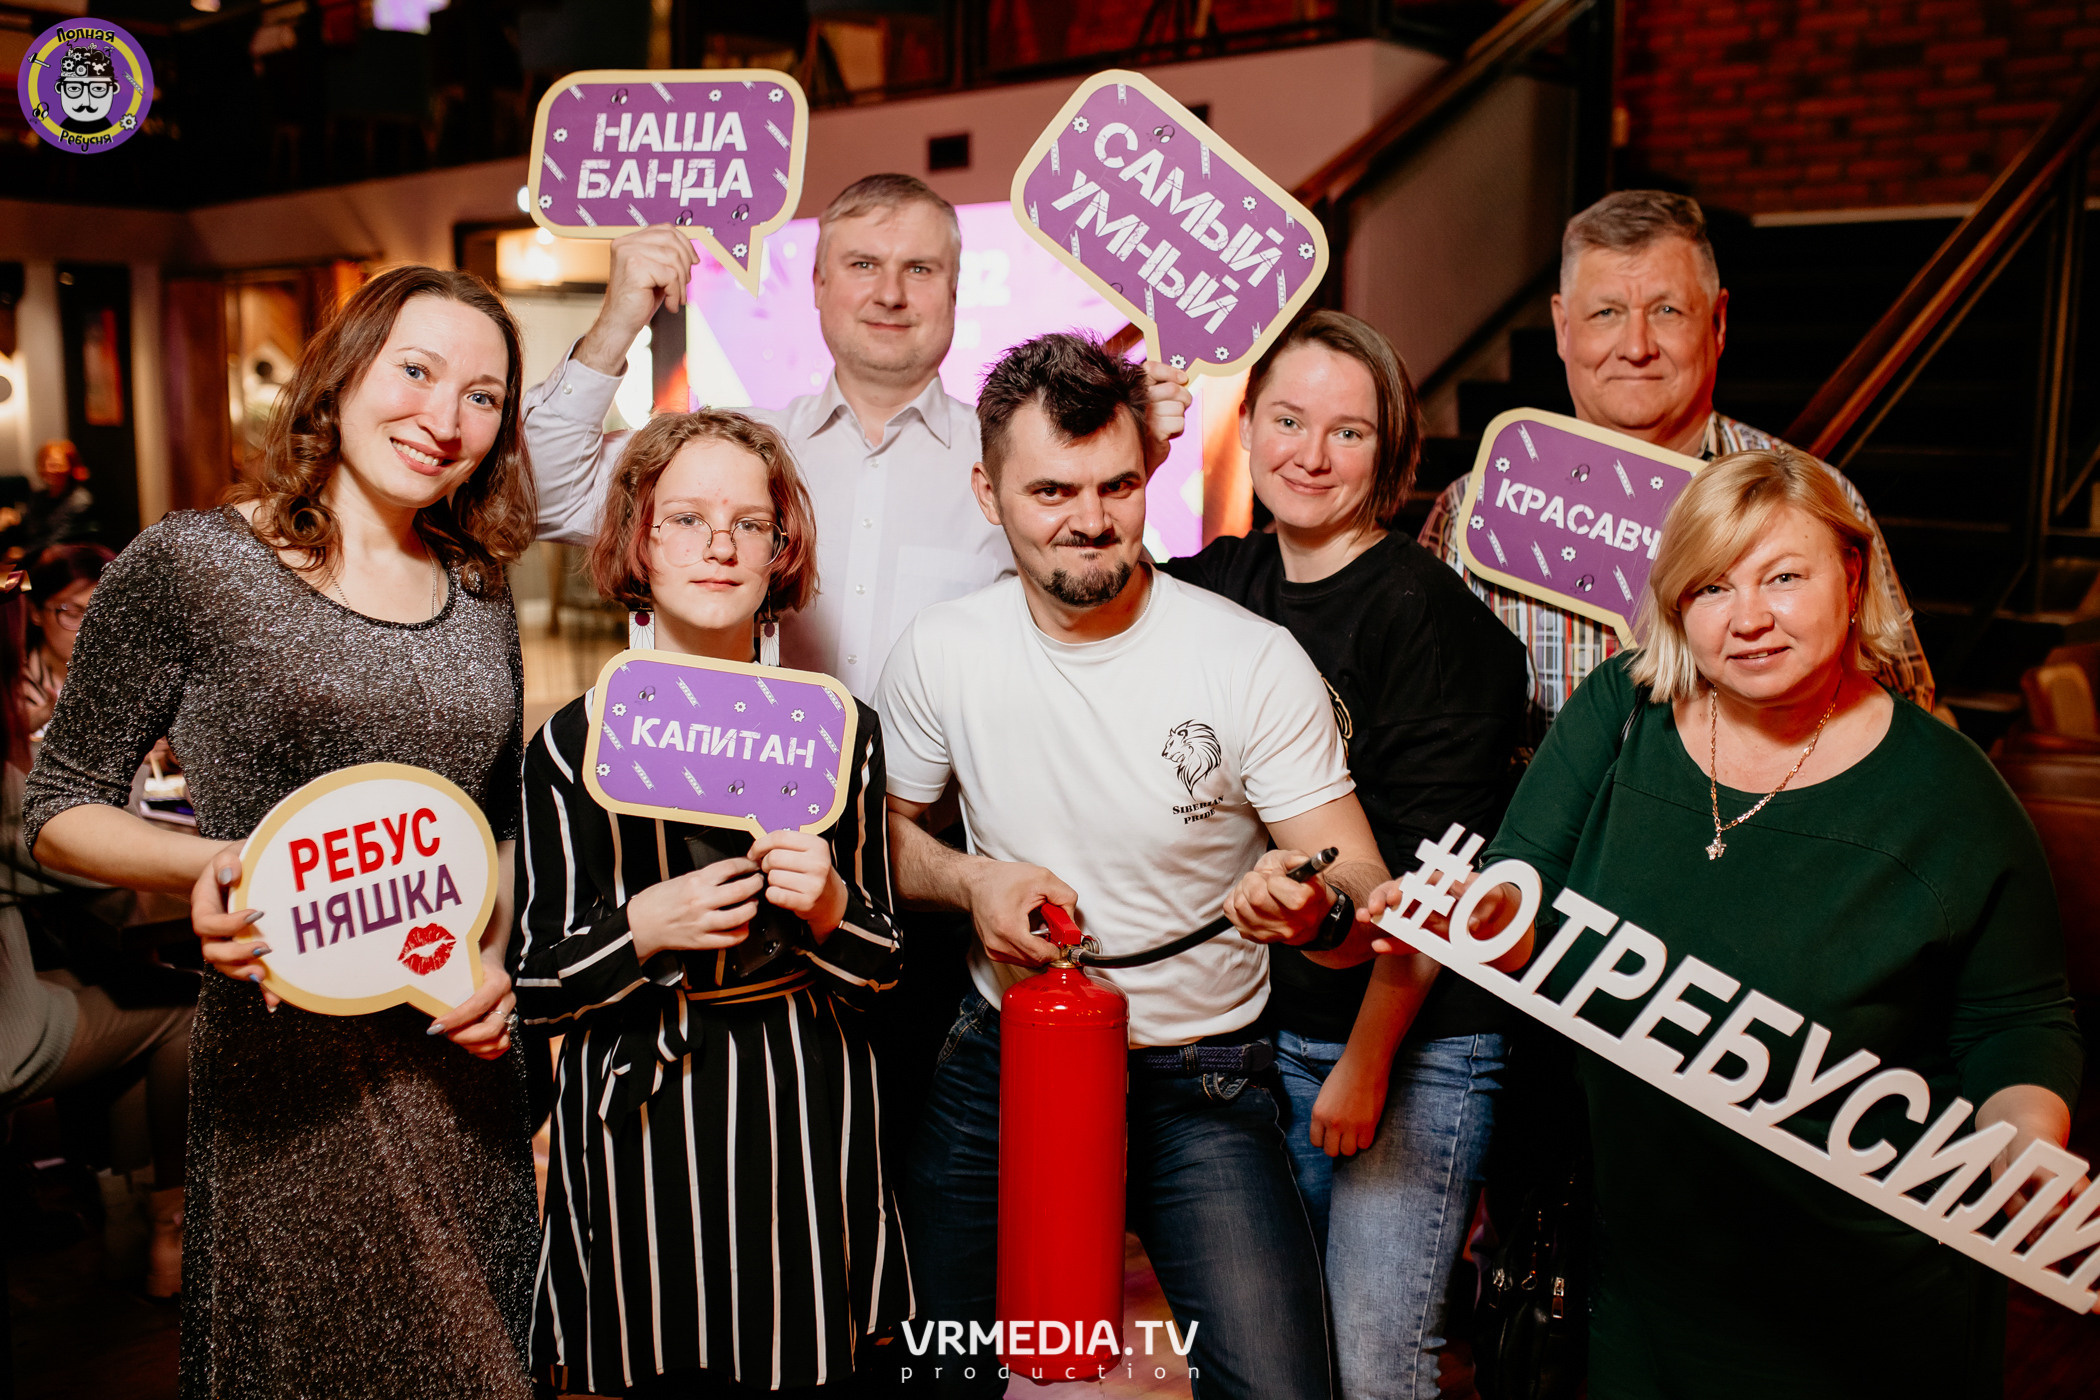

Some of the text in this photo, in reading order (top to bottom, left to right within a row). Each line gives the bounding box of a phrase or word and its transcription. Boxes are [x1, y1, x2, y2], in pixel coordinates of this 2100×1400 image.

[592, 112, 748, 153] НАША
[577, 158, 753, 207] БАНДА
[1094, 122, 1285, 288] САМЫЙ
[1051, 169, 1241, 335] УМНЫЙ
[631, 715, 816, 769] КАПИТАН
[288, 807, 441, 893] РЕБУС
[290, 863, 462, 955] НЯШКА
